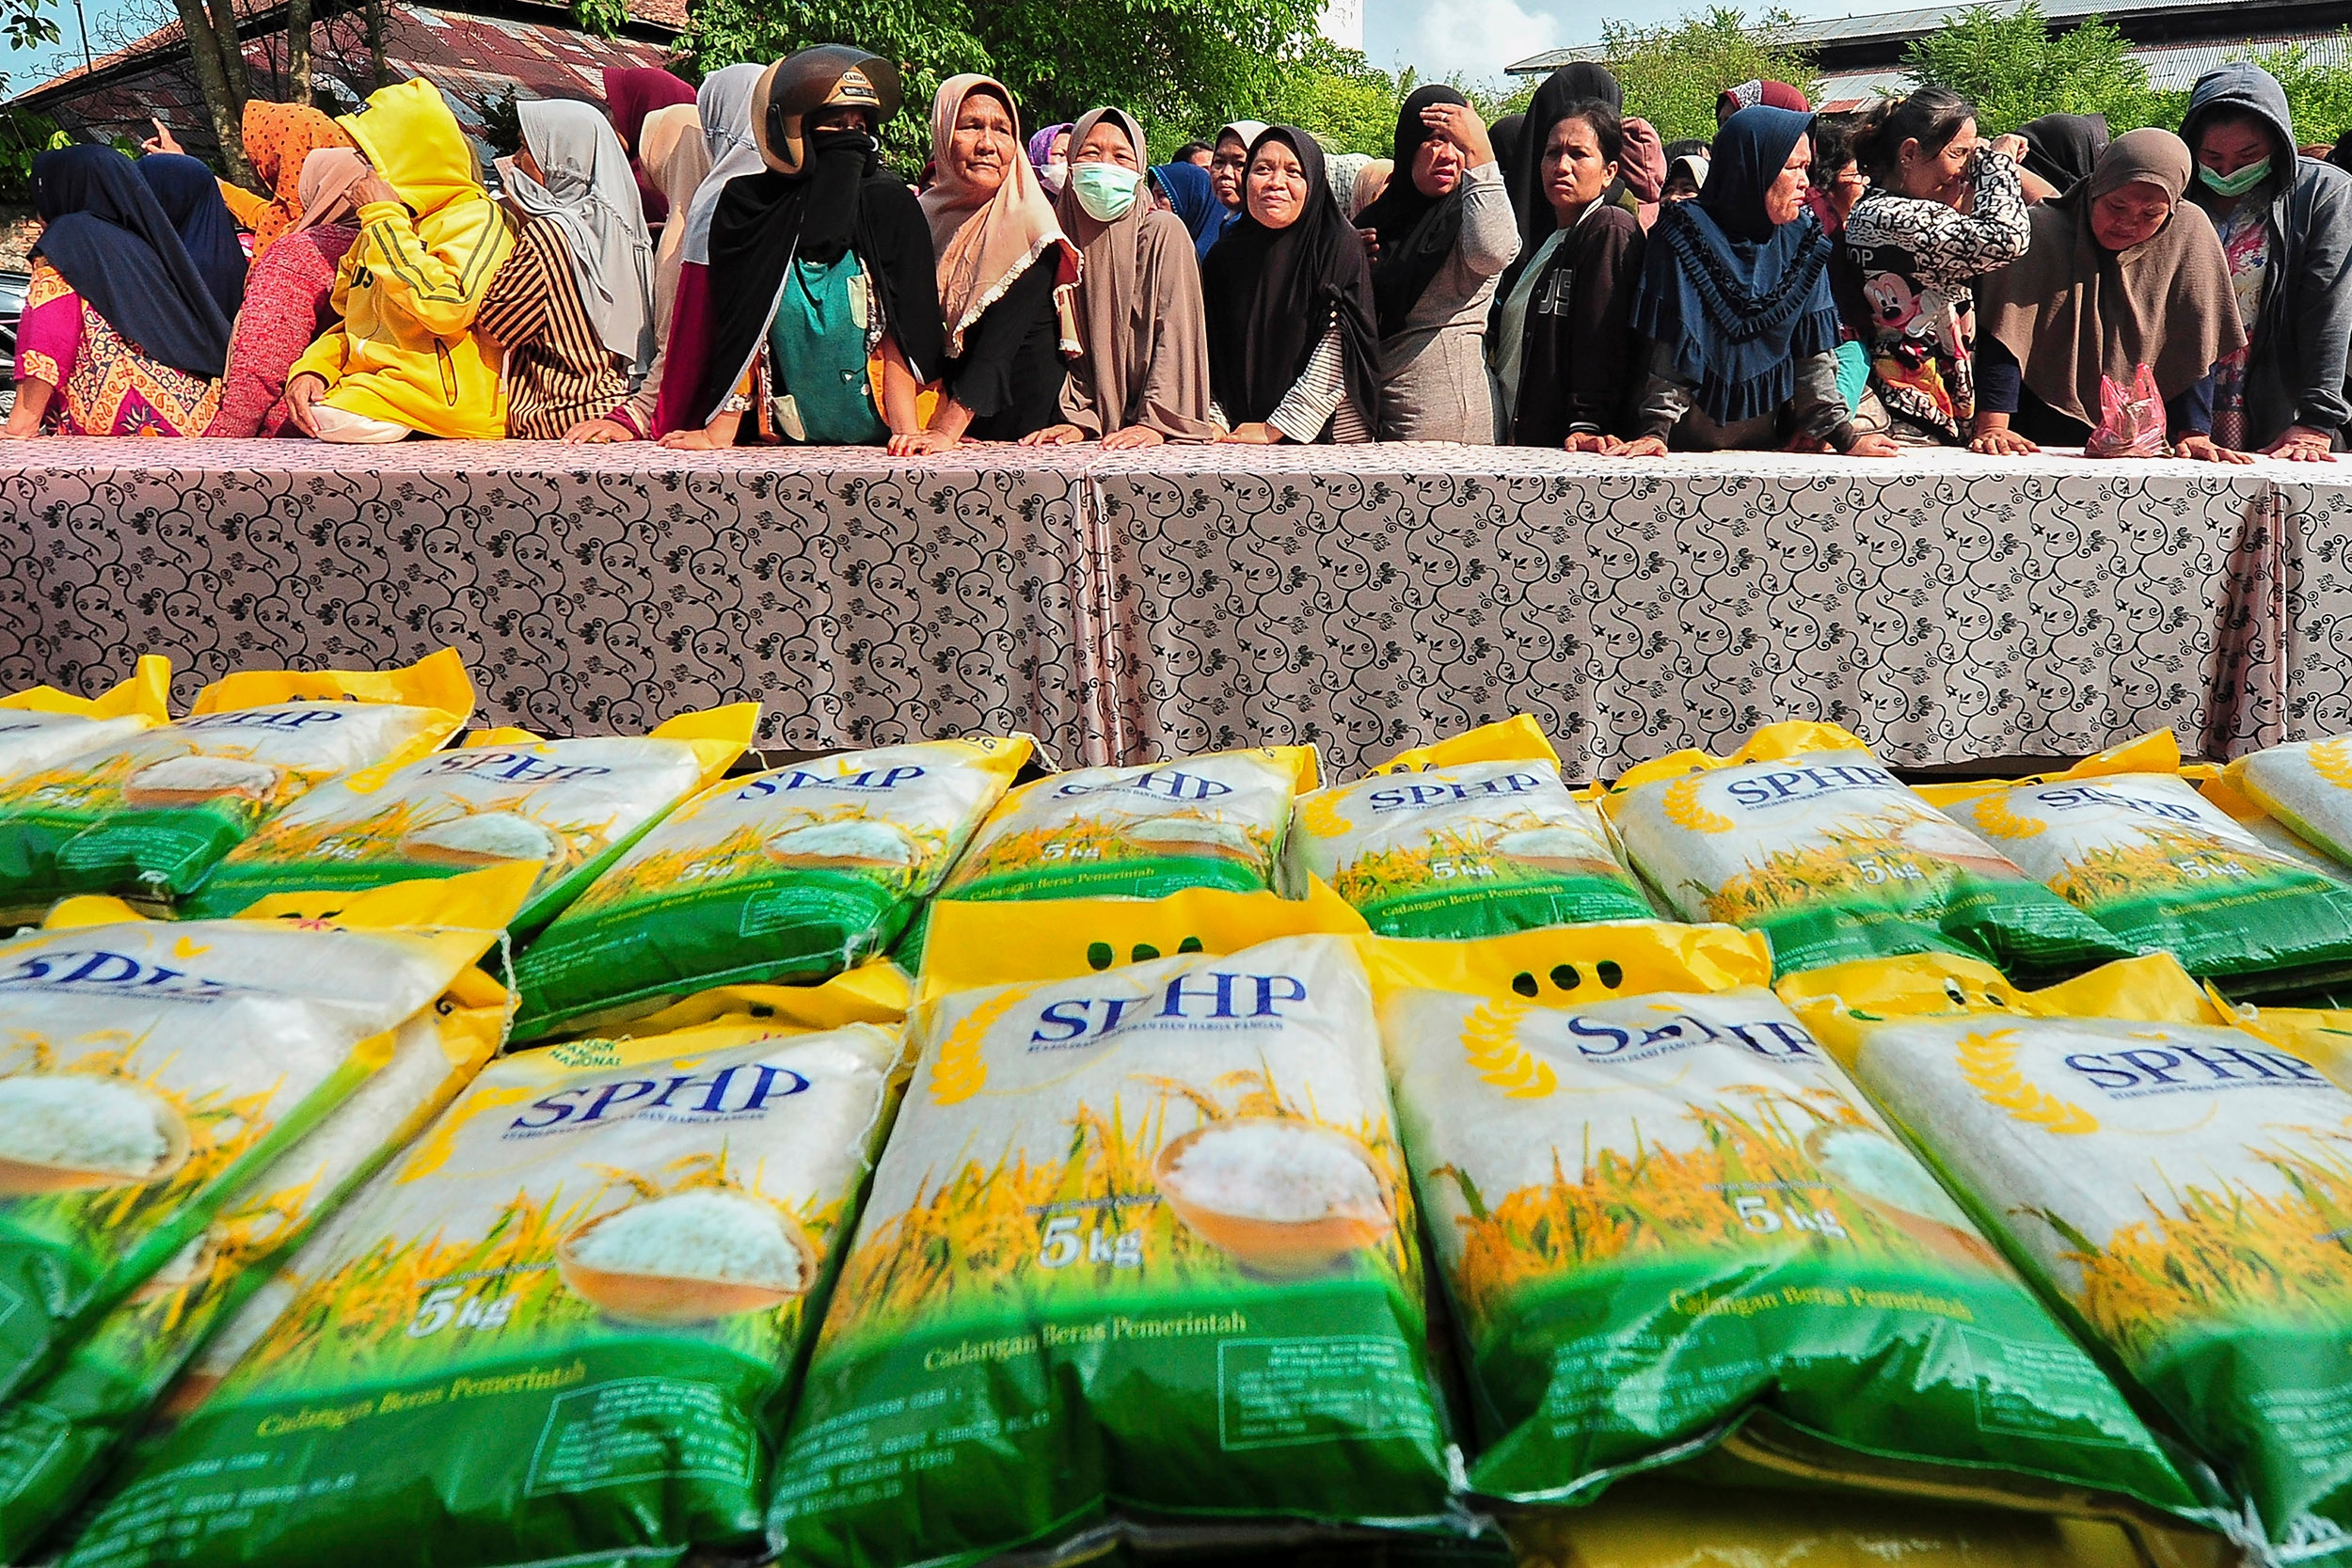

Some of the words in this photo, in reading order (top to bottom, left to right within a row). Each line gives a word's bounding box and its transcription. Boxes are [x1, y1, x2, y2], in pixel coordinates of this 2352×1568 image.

[1370, 773, 1541, 811] SPHP
[1727, 766, 1891, 806] SPHP
[1041, 843, 1067, 861] 5
[1433, 861, 1457, 880] 5
[2177, 860, 2211, 879] 5
[676, 862, 707, 882] 5
[1857, 859, 1887, 885] 5
[1884, 862, 1924, 880] kg
[1382, 897, 1447, 917] Cadangan
[1449, 892, 1486, 906] Beras
[2065, 1045, 2325, 1089] SPHP
[510, 1064, 812, 1129] SPHP
[1734, 1196, 1784, 1236] 5
[1784, 1202, 1849, 1240] kg
[1039, 1216, 1082, 1268] 5
[1089, 1228, 1142, 1268] kg
[406, 1285, 467, 1339] 5
[455, 1292, 519, 1332] kg
[923, 1329, 1038, 1372] Cadangan
[1042, 1319, 1105, 1345] Beras
[1112, 1309, 1248, 1340] Pemerintah
